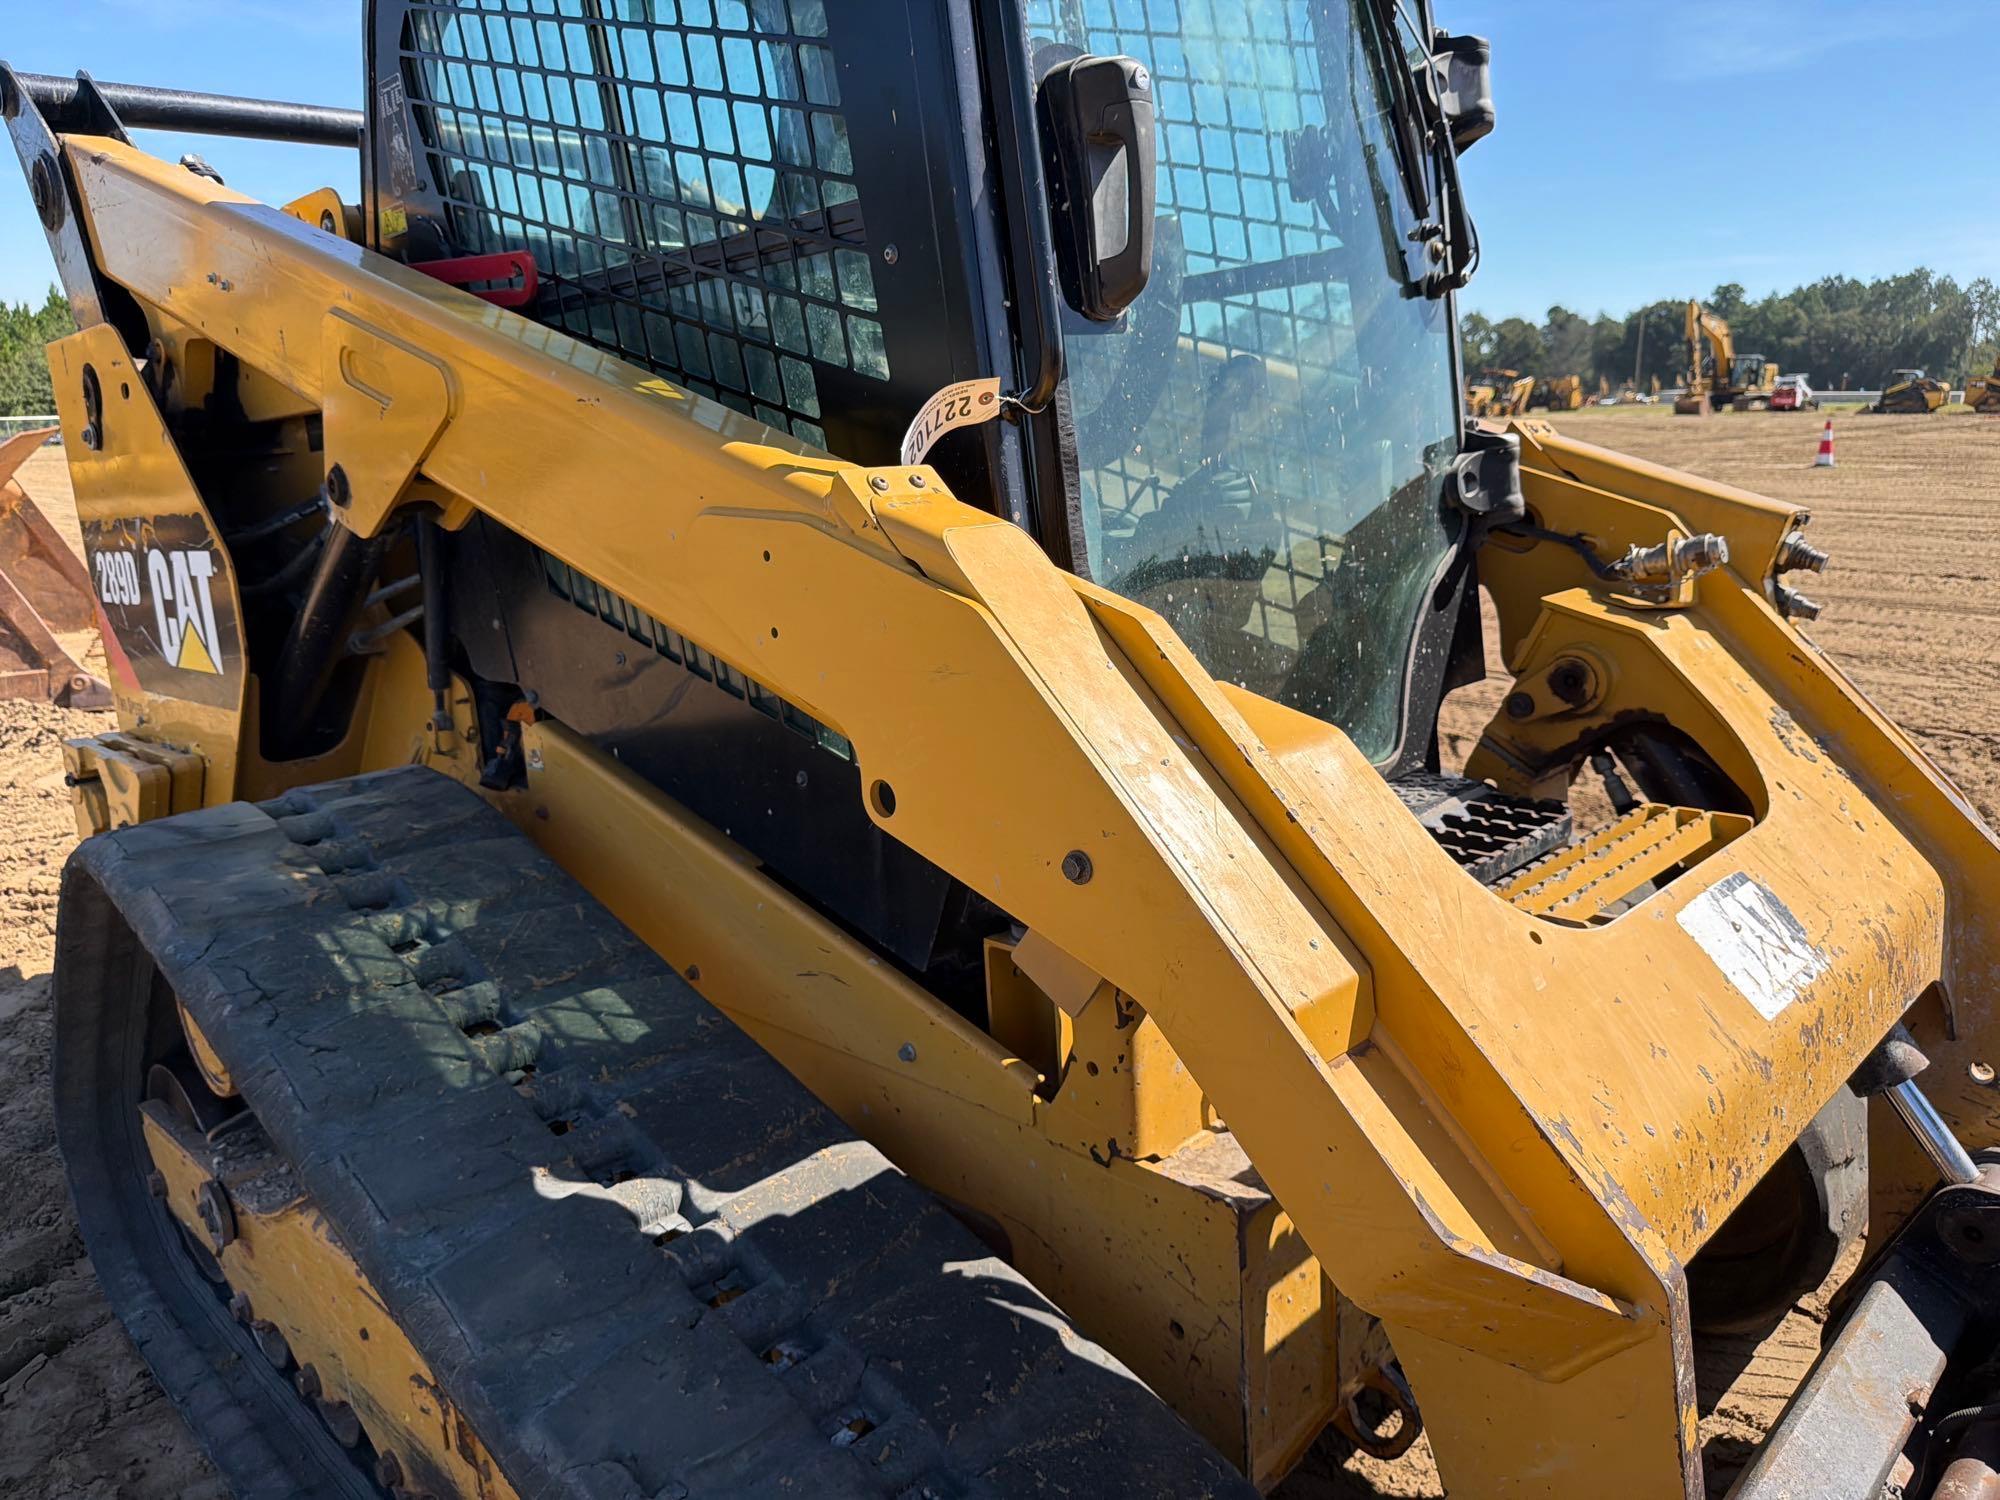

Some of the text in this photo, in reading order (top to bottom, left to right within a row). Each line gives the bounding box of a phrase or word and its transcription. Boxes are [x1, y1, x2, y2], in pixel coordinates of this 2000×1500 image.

[732, 290, 775, 328] CA
[909, 395, 971, 465] 227102
[95, 550, 142, 606] 289D
[147, 548, 224, 676] CAT
